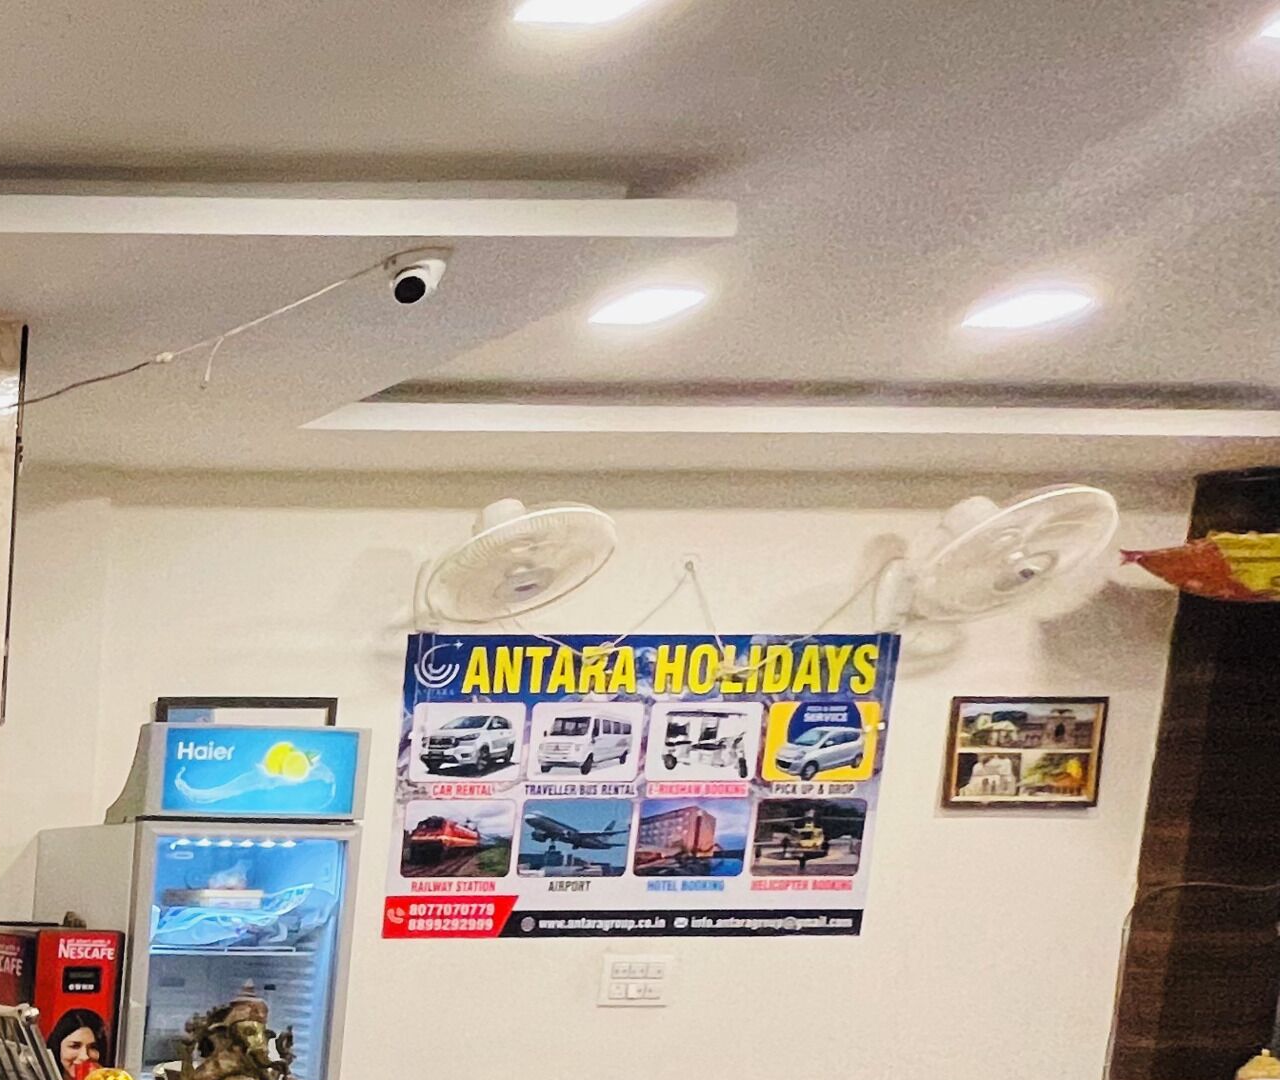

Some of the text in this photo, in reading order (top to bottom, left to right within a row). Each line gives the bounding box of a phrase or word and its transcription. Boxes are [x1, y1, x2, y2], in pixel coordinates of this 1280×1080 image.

[460, 643, 880, 695] ANTARA HOLIDAYS
[176, 741, 236, 762] Haier
[431, 784, 494, 796] CAR RENTAL
[524, 784, 636, 797] TRAVELLER BUS RENTAL
[800, 784, 816, 795] UP
[828, 784, 856, 795] DROP
[410, 881, 496, 893] RAILWAY STATION
[547, 880, 592, 892] AIRPORT
[646, 879, 678, 892] HOTEL
[408, 903, 496, 916] 8077070779
